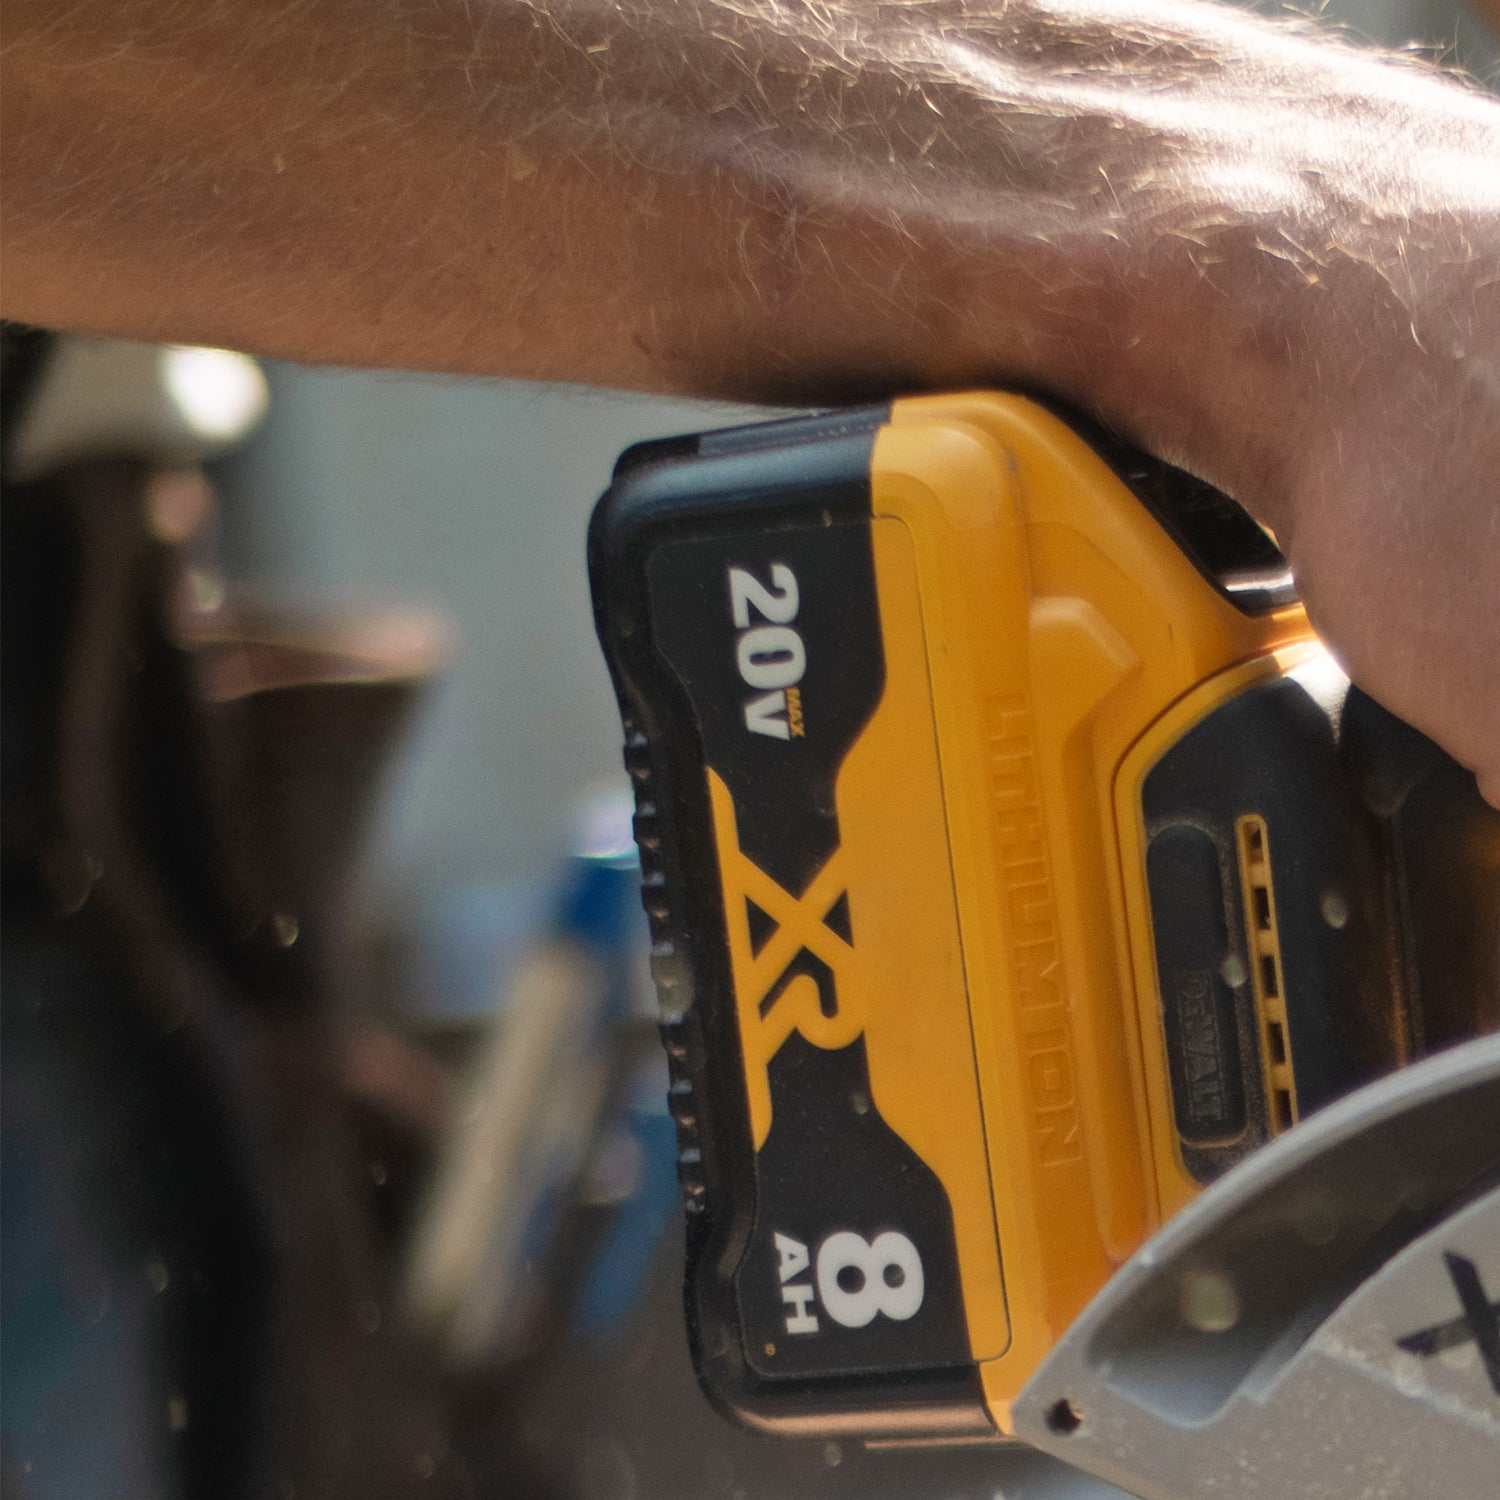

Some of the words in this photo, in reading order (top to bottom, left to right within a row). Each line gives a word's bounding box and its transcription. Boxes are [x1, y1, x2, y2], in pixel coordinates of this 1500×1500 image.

[728, 563, 806, 741] 20V
[988, 695, 1076, 1013] LITHIUM
[708, 800, 868, 1090] XR
[1024, 1027, 1084, 1168] ION
[774, 1231, 820, 1335] AH
[816, 1231, 924, 1327] 8
